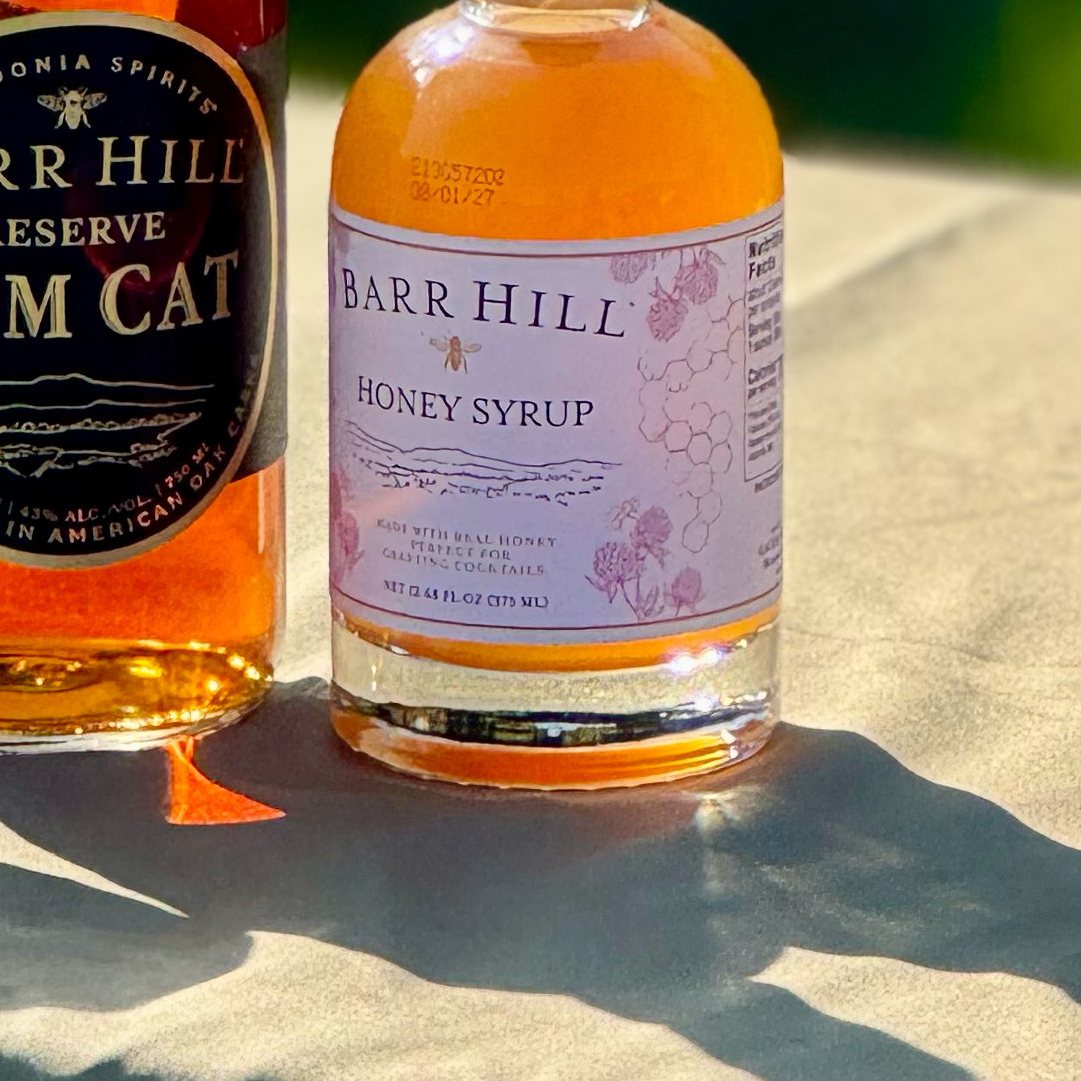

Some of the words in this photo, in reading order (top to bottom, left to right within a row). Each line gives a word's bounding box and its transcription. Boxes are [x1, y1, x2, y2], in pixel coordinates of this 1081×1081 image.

[110, 56, 218, 115] SPIRITS
[95, 135, 244, 186] HILL
[99, 248, 240, 336] CAT
[342, 267, 455, 319] BARR
[471, 280, 626, 338] HILL
[357, 375, 462, 422] HONEY
[471, 397, 594, 427] SYRUP
[5, 520, 35, 540] IN
[47, 491, 183, 544] AMERICAN
[189, 444, 227, 492] OAK
